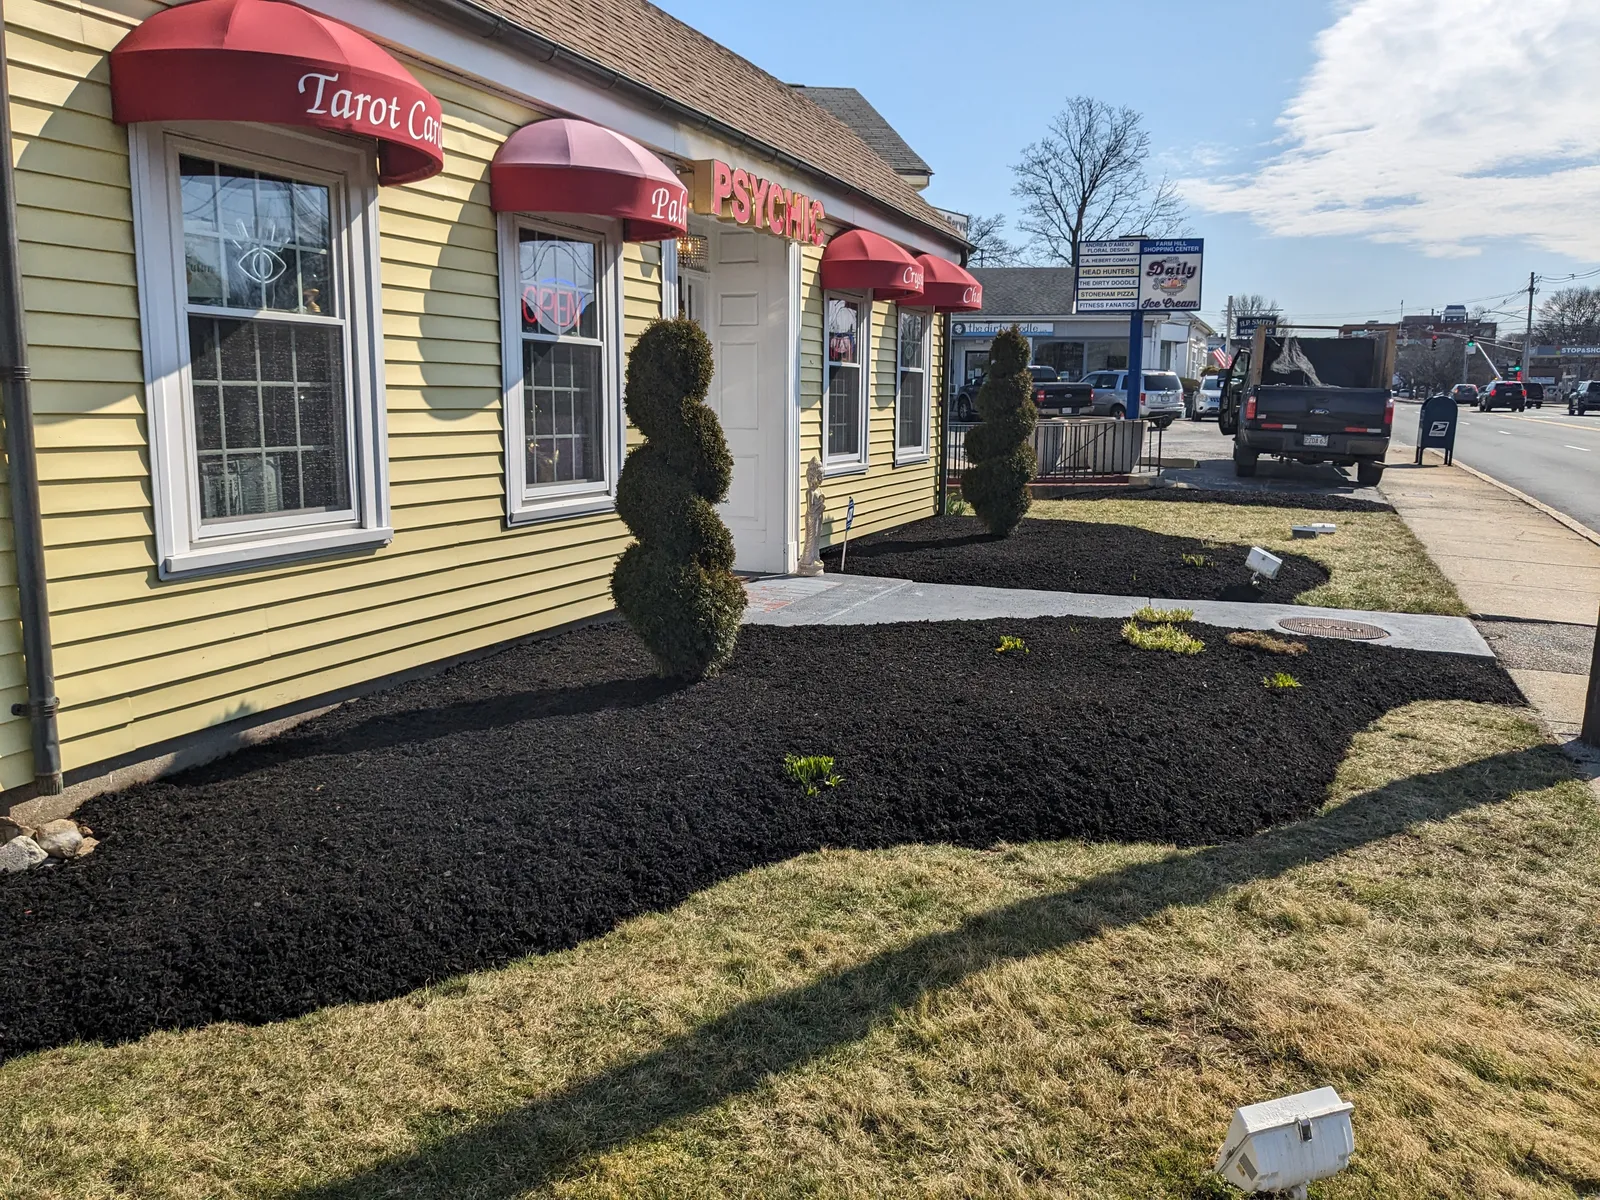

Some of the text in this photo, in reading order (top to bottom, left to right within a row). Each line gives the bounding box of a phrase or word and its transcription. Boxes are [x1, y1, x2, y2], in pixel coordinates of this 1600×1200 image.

[298, 72, 400, 130] Tarot
[712, 159, 826, 247] PSYCHIC
[1146, 260, 1198, 279] Daily
[522, 285, 583, 328] OPEN
[1142, 298, 1198, 308] Ice Cream
[968, 323, 982, 332] the
[984, 323, 1008, 332] dirty
